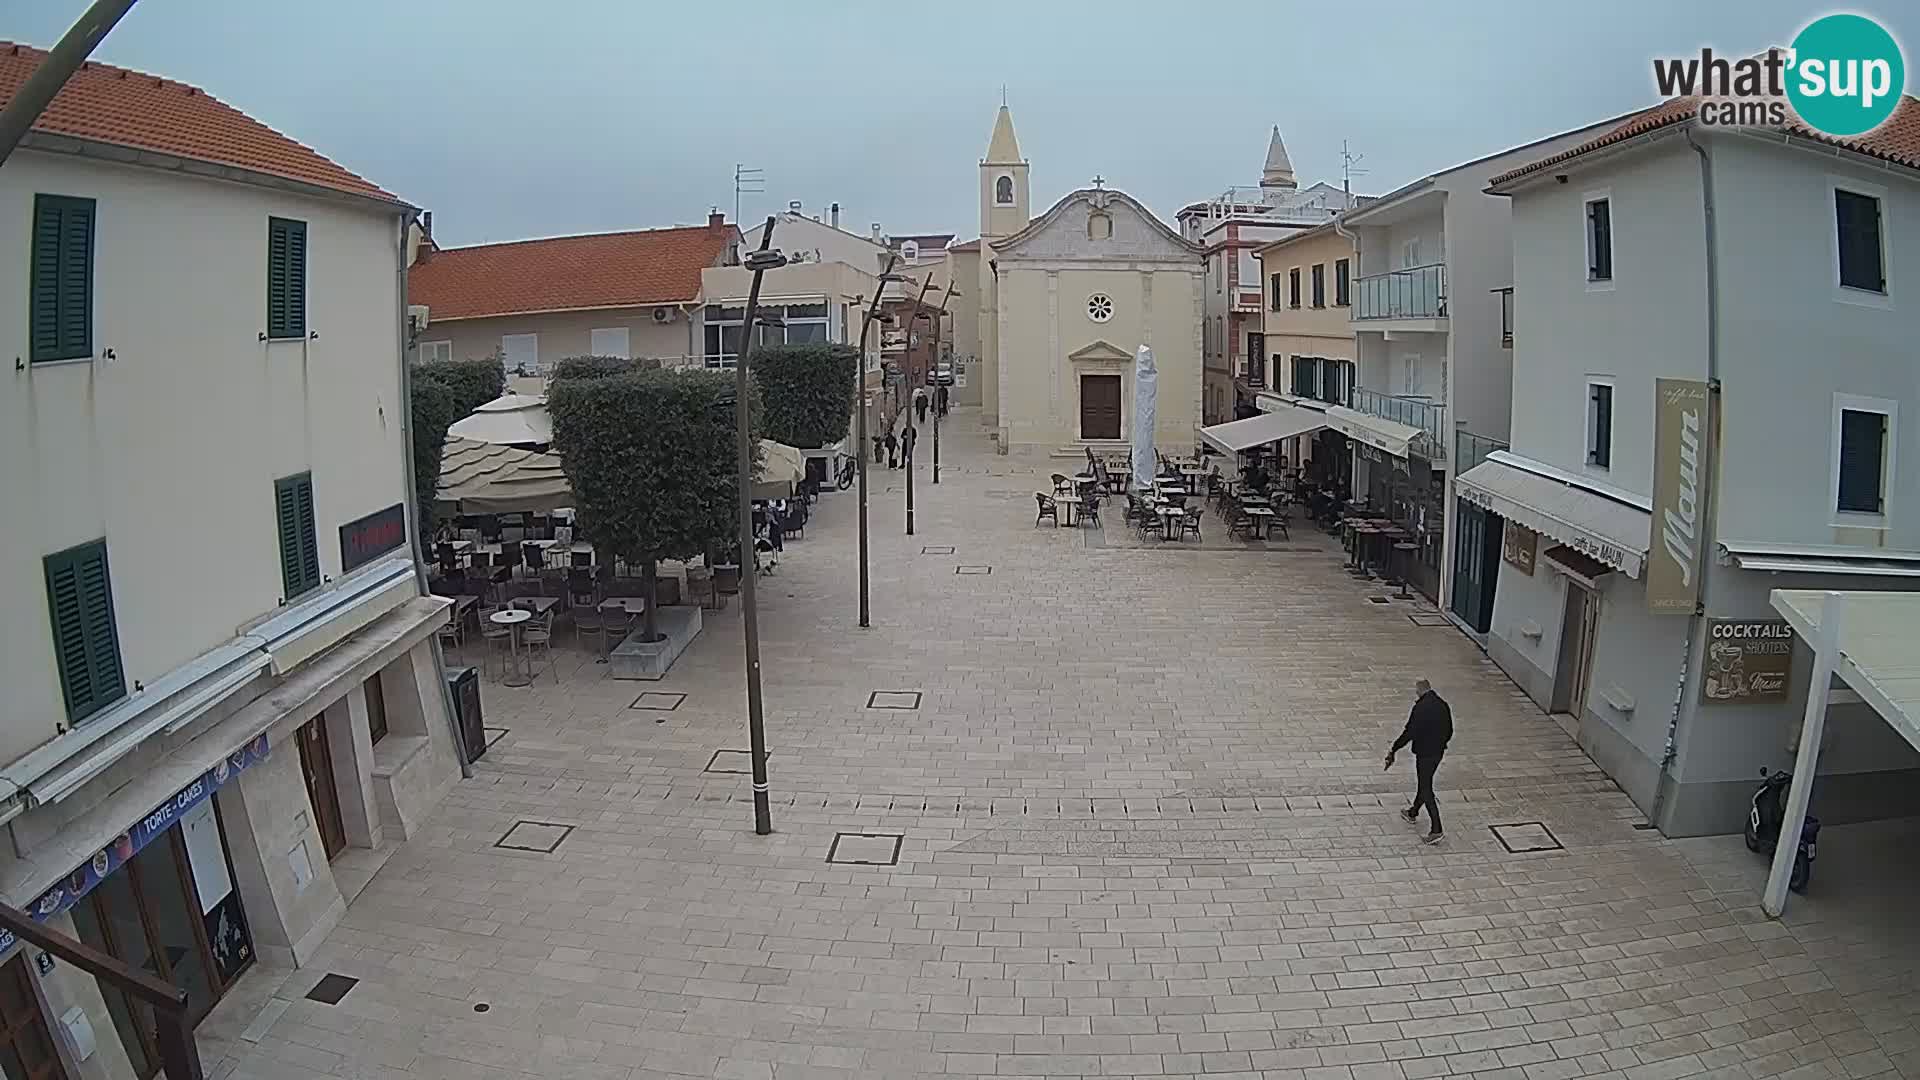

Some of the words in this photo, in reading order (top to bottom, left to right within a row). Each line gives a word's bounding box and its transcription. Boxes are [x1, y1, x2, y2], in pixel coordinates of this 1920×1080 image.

[1663, 408, 1699, 587] Maun
[1600, 543, 1624, 567] MAUN
[1712, 624, 1792, 638] COCKTAILS
[144, 803, 173, 834] TORTE
[177, 780, 203, 809] CAKES
